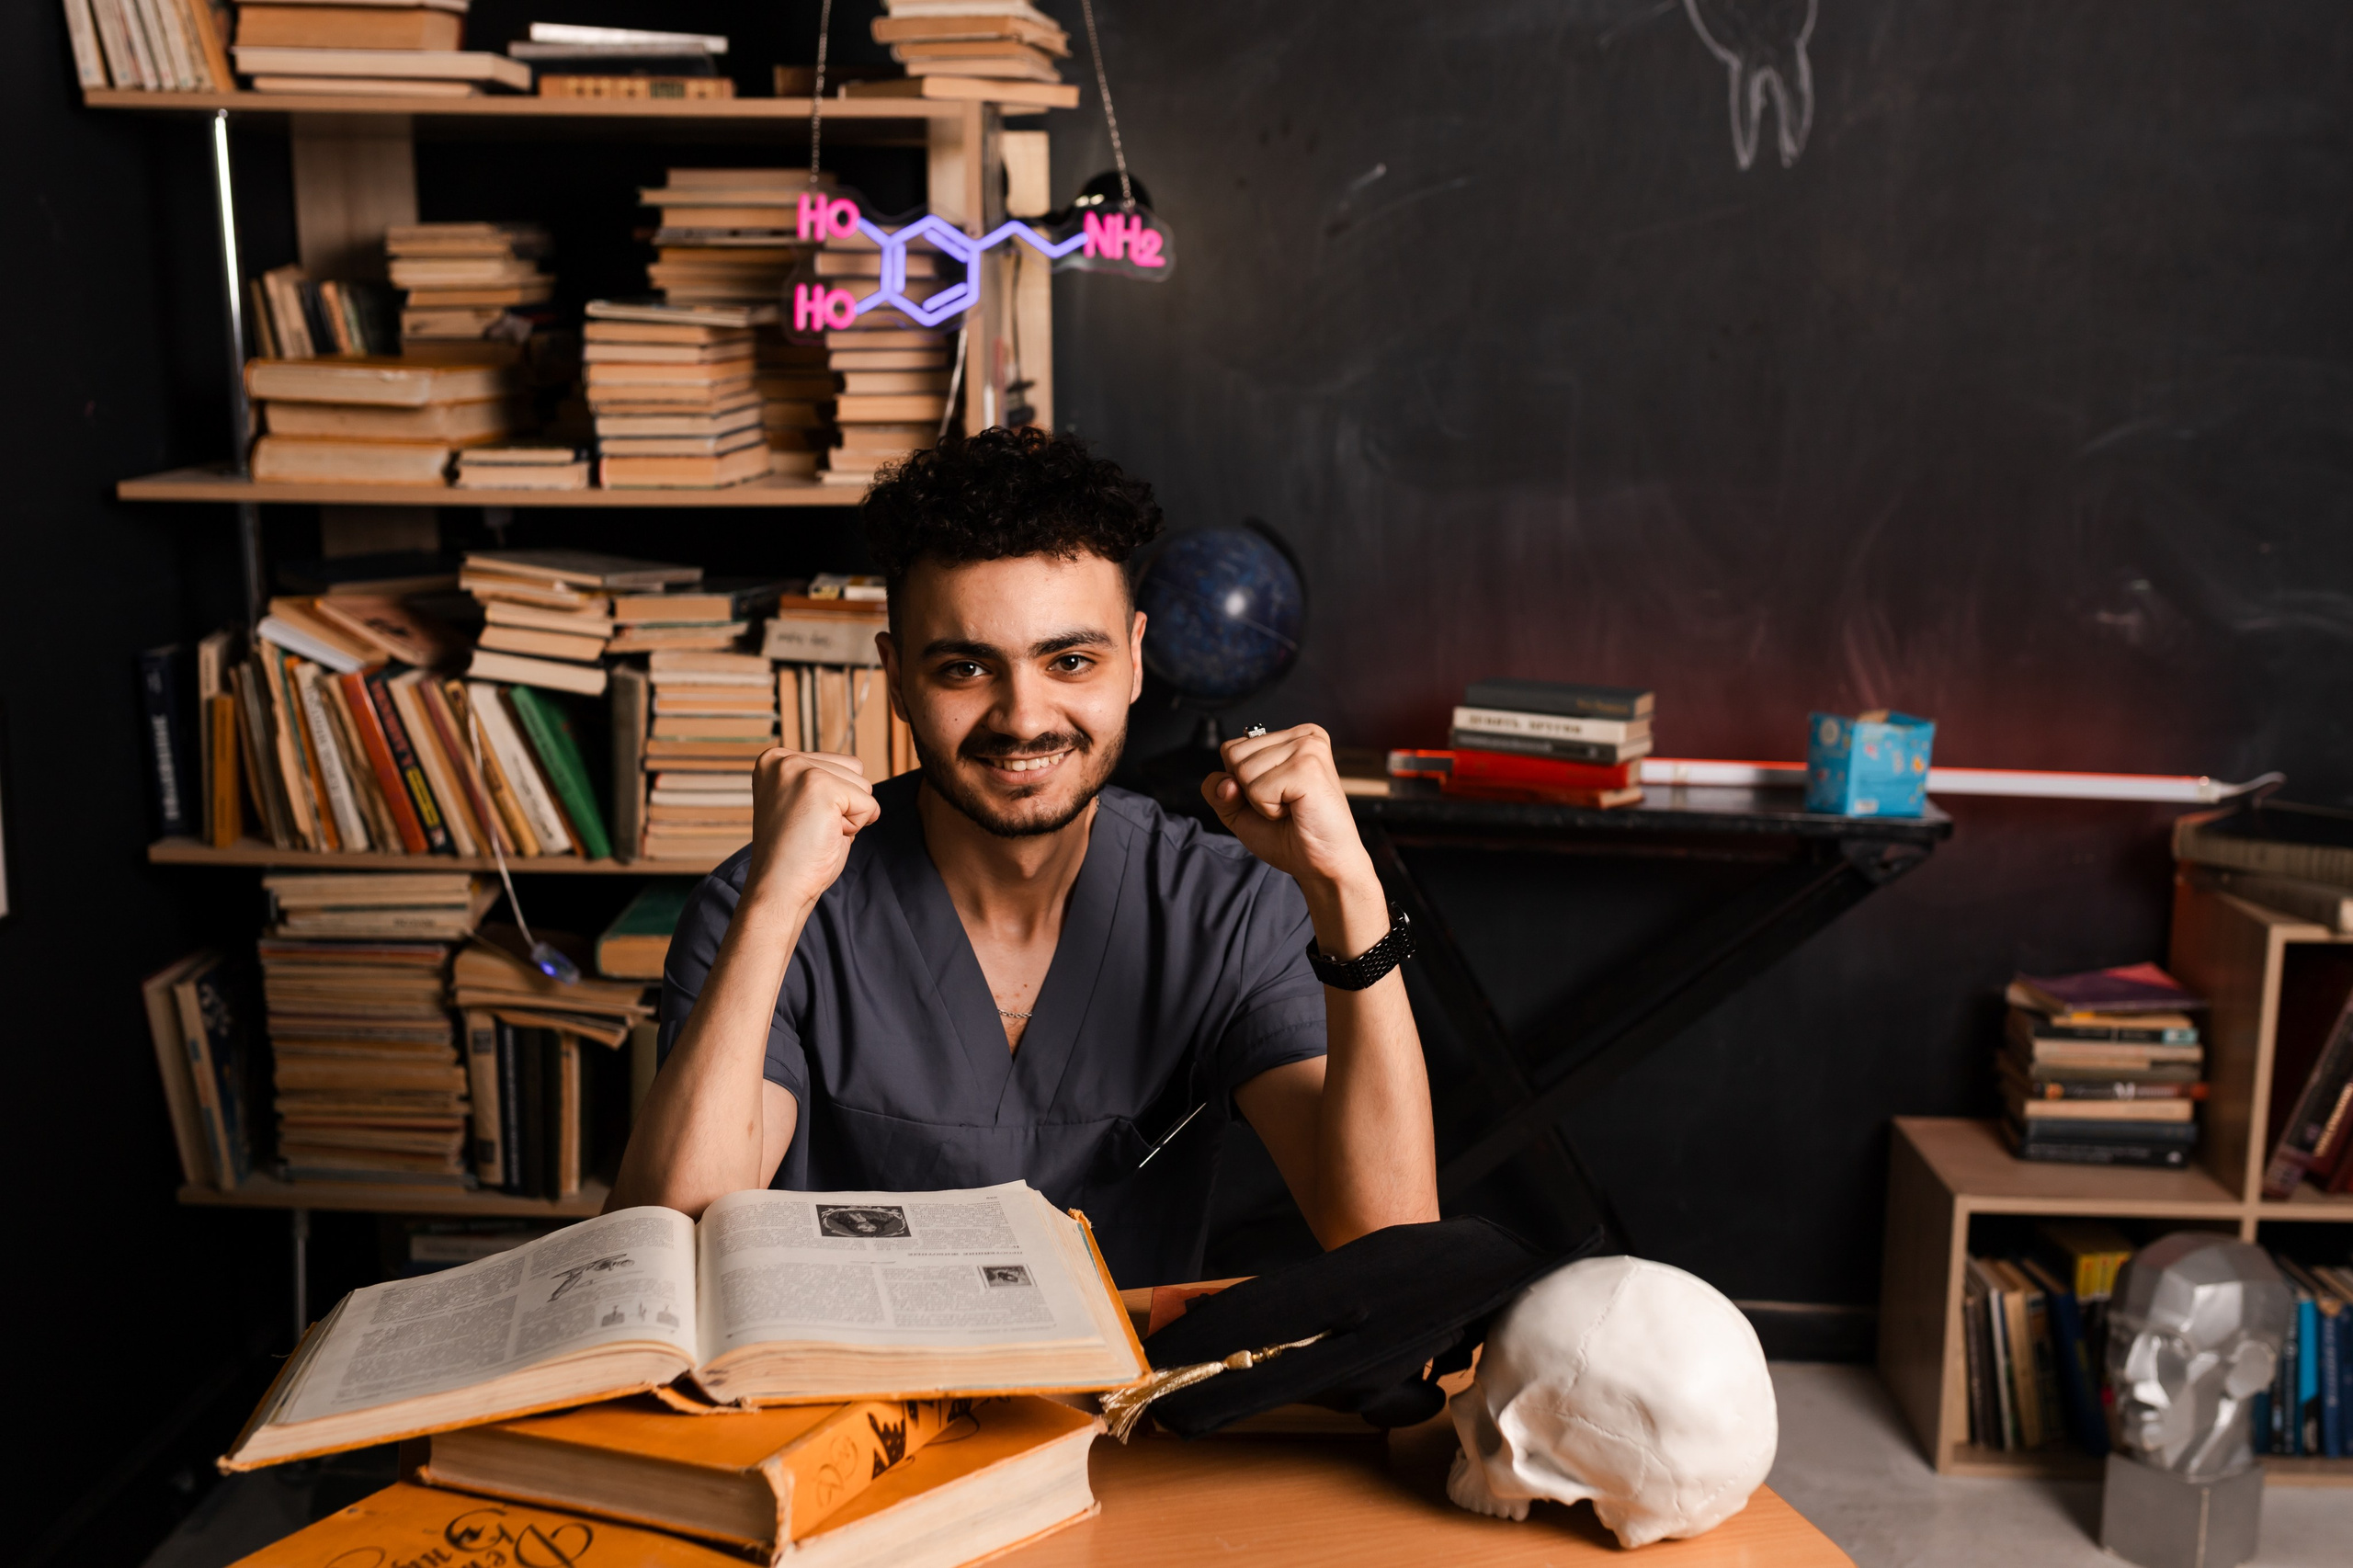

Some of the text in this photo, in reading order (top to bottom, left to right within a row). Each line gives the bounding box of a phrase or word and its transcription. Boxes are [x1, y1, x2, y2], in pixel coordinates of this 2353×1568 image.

[797, 192, 861, 243] HO
[1083, 210, 1166, 267] NH2
[793, 283, 858, 332] HO
